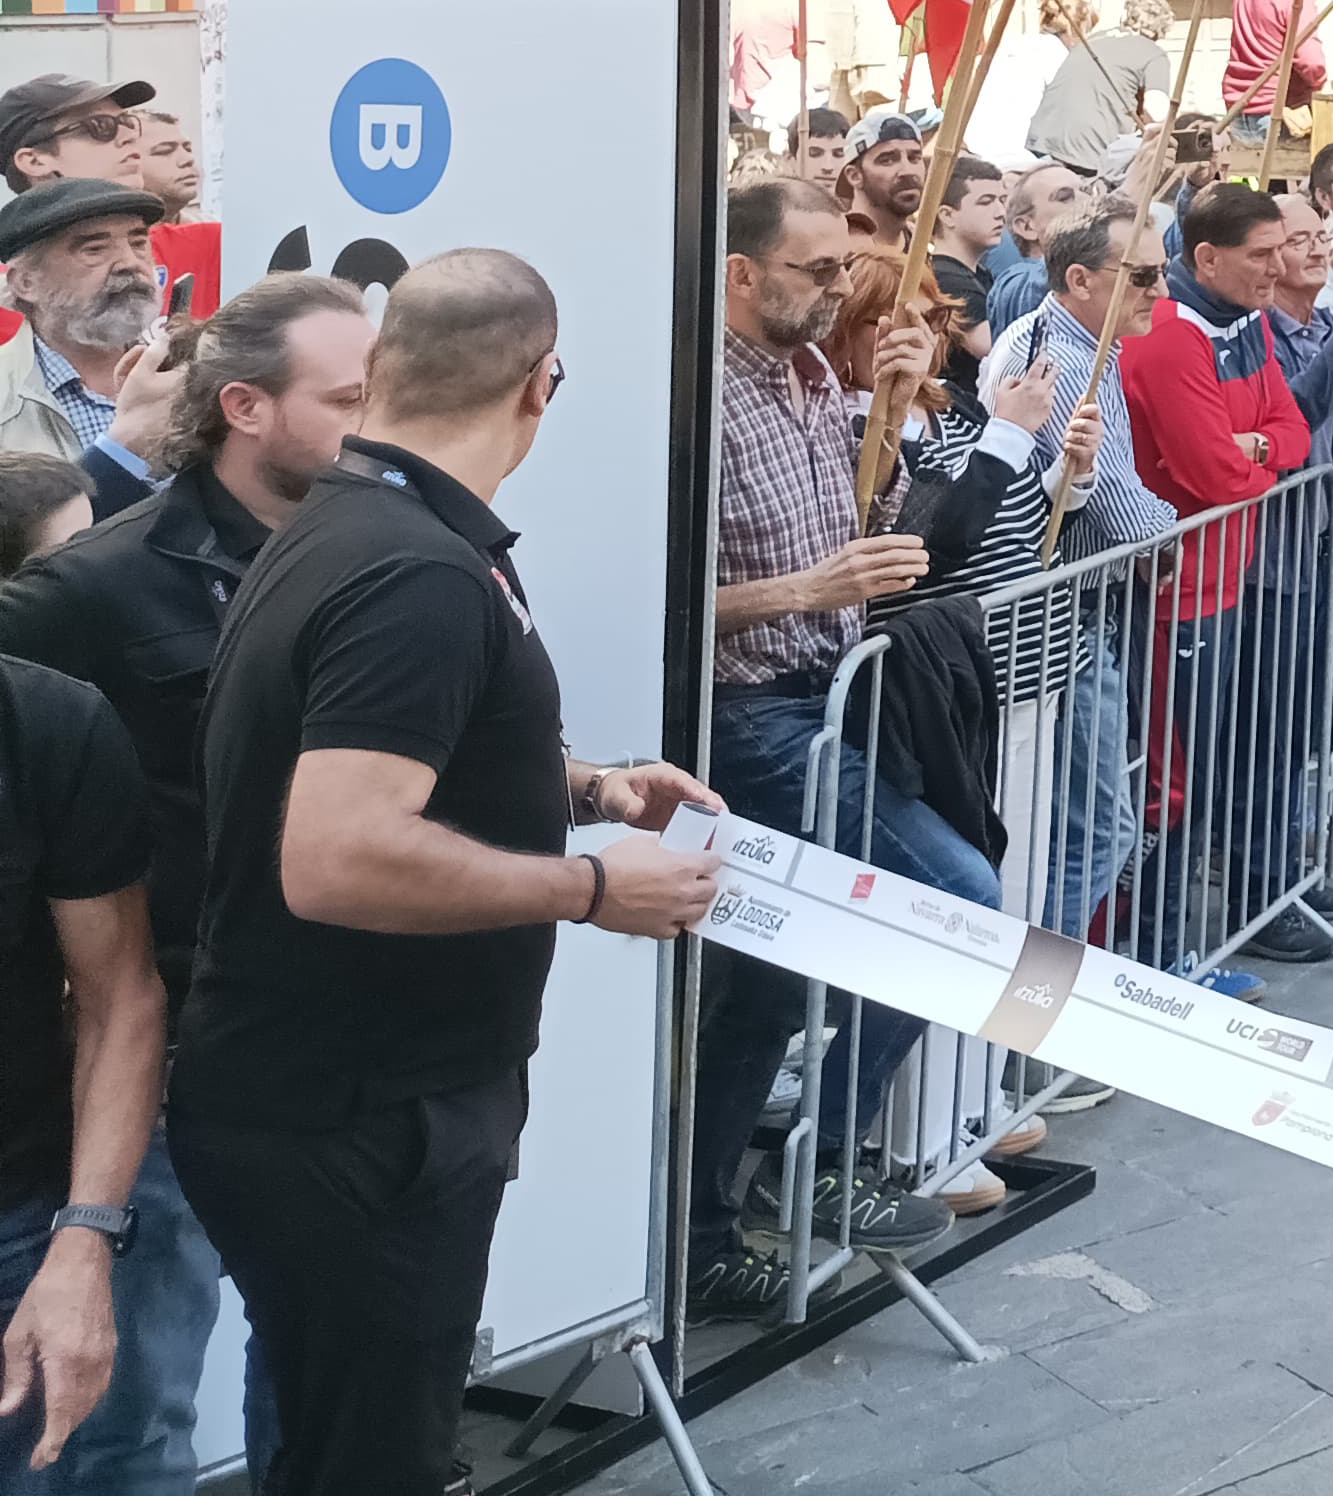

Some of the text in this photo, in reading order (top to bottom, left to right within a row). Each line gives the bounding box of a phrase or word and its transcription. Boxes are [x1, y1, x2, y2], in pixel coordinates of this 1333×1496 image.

[737, 903, 785, 933] LODOSA
[1120, 980, 1195, 1021] Sabadell
[1226, 1017, 1260, 1042] UCI
